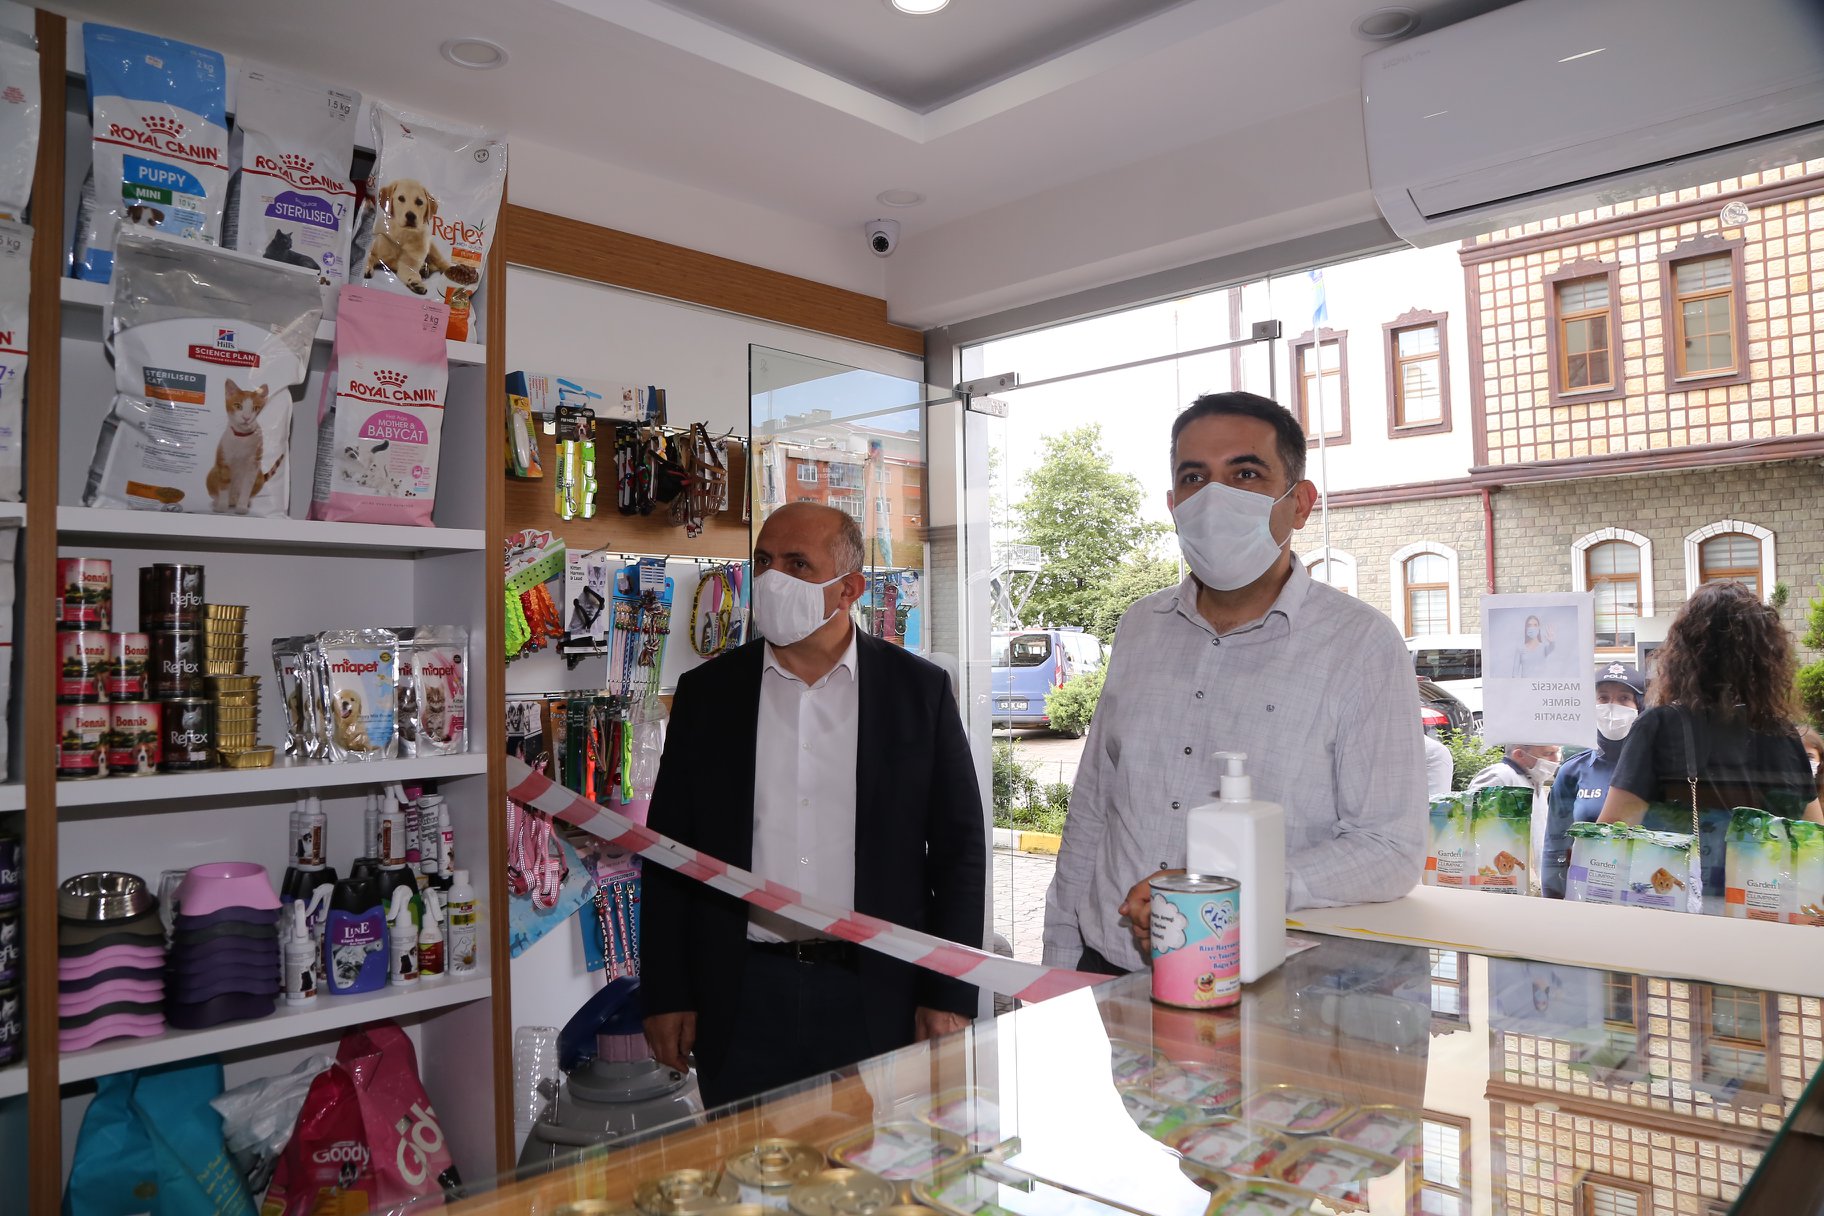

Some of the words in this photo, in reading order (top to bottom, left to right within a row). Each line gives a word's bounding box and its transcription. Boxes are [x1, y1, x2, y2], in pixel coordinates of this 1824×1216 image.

[339, 102, 351, 114] kg
[110, 123, 162, 149] ROYAL
[165, 140, 218, 160] CANIN
[138, 165, 187, 187] PUPPY
[255, 155, 297, 183] ROYAL
[299, 175, 344, 191] CANIN
[135, 187, 161, 200] MINI
[274, 202, 334, 225] STERILISED
[431, 215, 485, 246] Reflex
[423, 313, 430, 322] 2
[430, 314, 439, 326] kg
[195, 347, 231, 358] SCIENCE
[232, 353, 254, 361] PLAN
[145, 369, 197, 382] STERILISED
[146, 377, 162, 385] CAT
[350, 380, 390, 399] ROYAL
[392, 389, 436, 402] CANIN
[378, 419, 409, 429] MOTHER
[367, 424, 424, 442] BABYCAT
[163, 659, 199, 675] Reflex
[332, 658, 379, 676] miapet
[422, 663, 455, 678] miapet
[115, 715, 148, 727] Bonnie
[170, 729, 208, 747] Reflex
[1577, 788, 1602, 799] OLİS
[1437, 849, 1463, 858] Garden
[1589, 858, 1616, 869] Garden
[1746, 879, 1777, 889] Garden
[1746, 893, 1779, 902] CLUMPING
[344, 921, 370, 939] LINE
[312, 1141, 370, 1165] Goody
